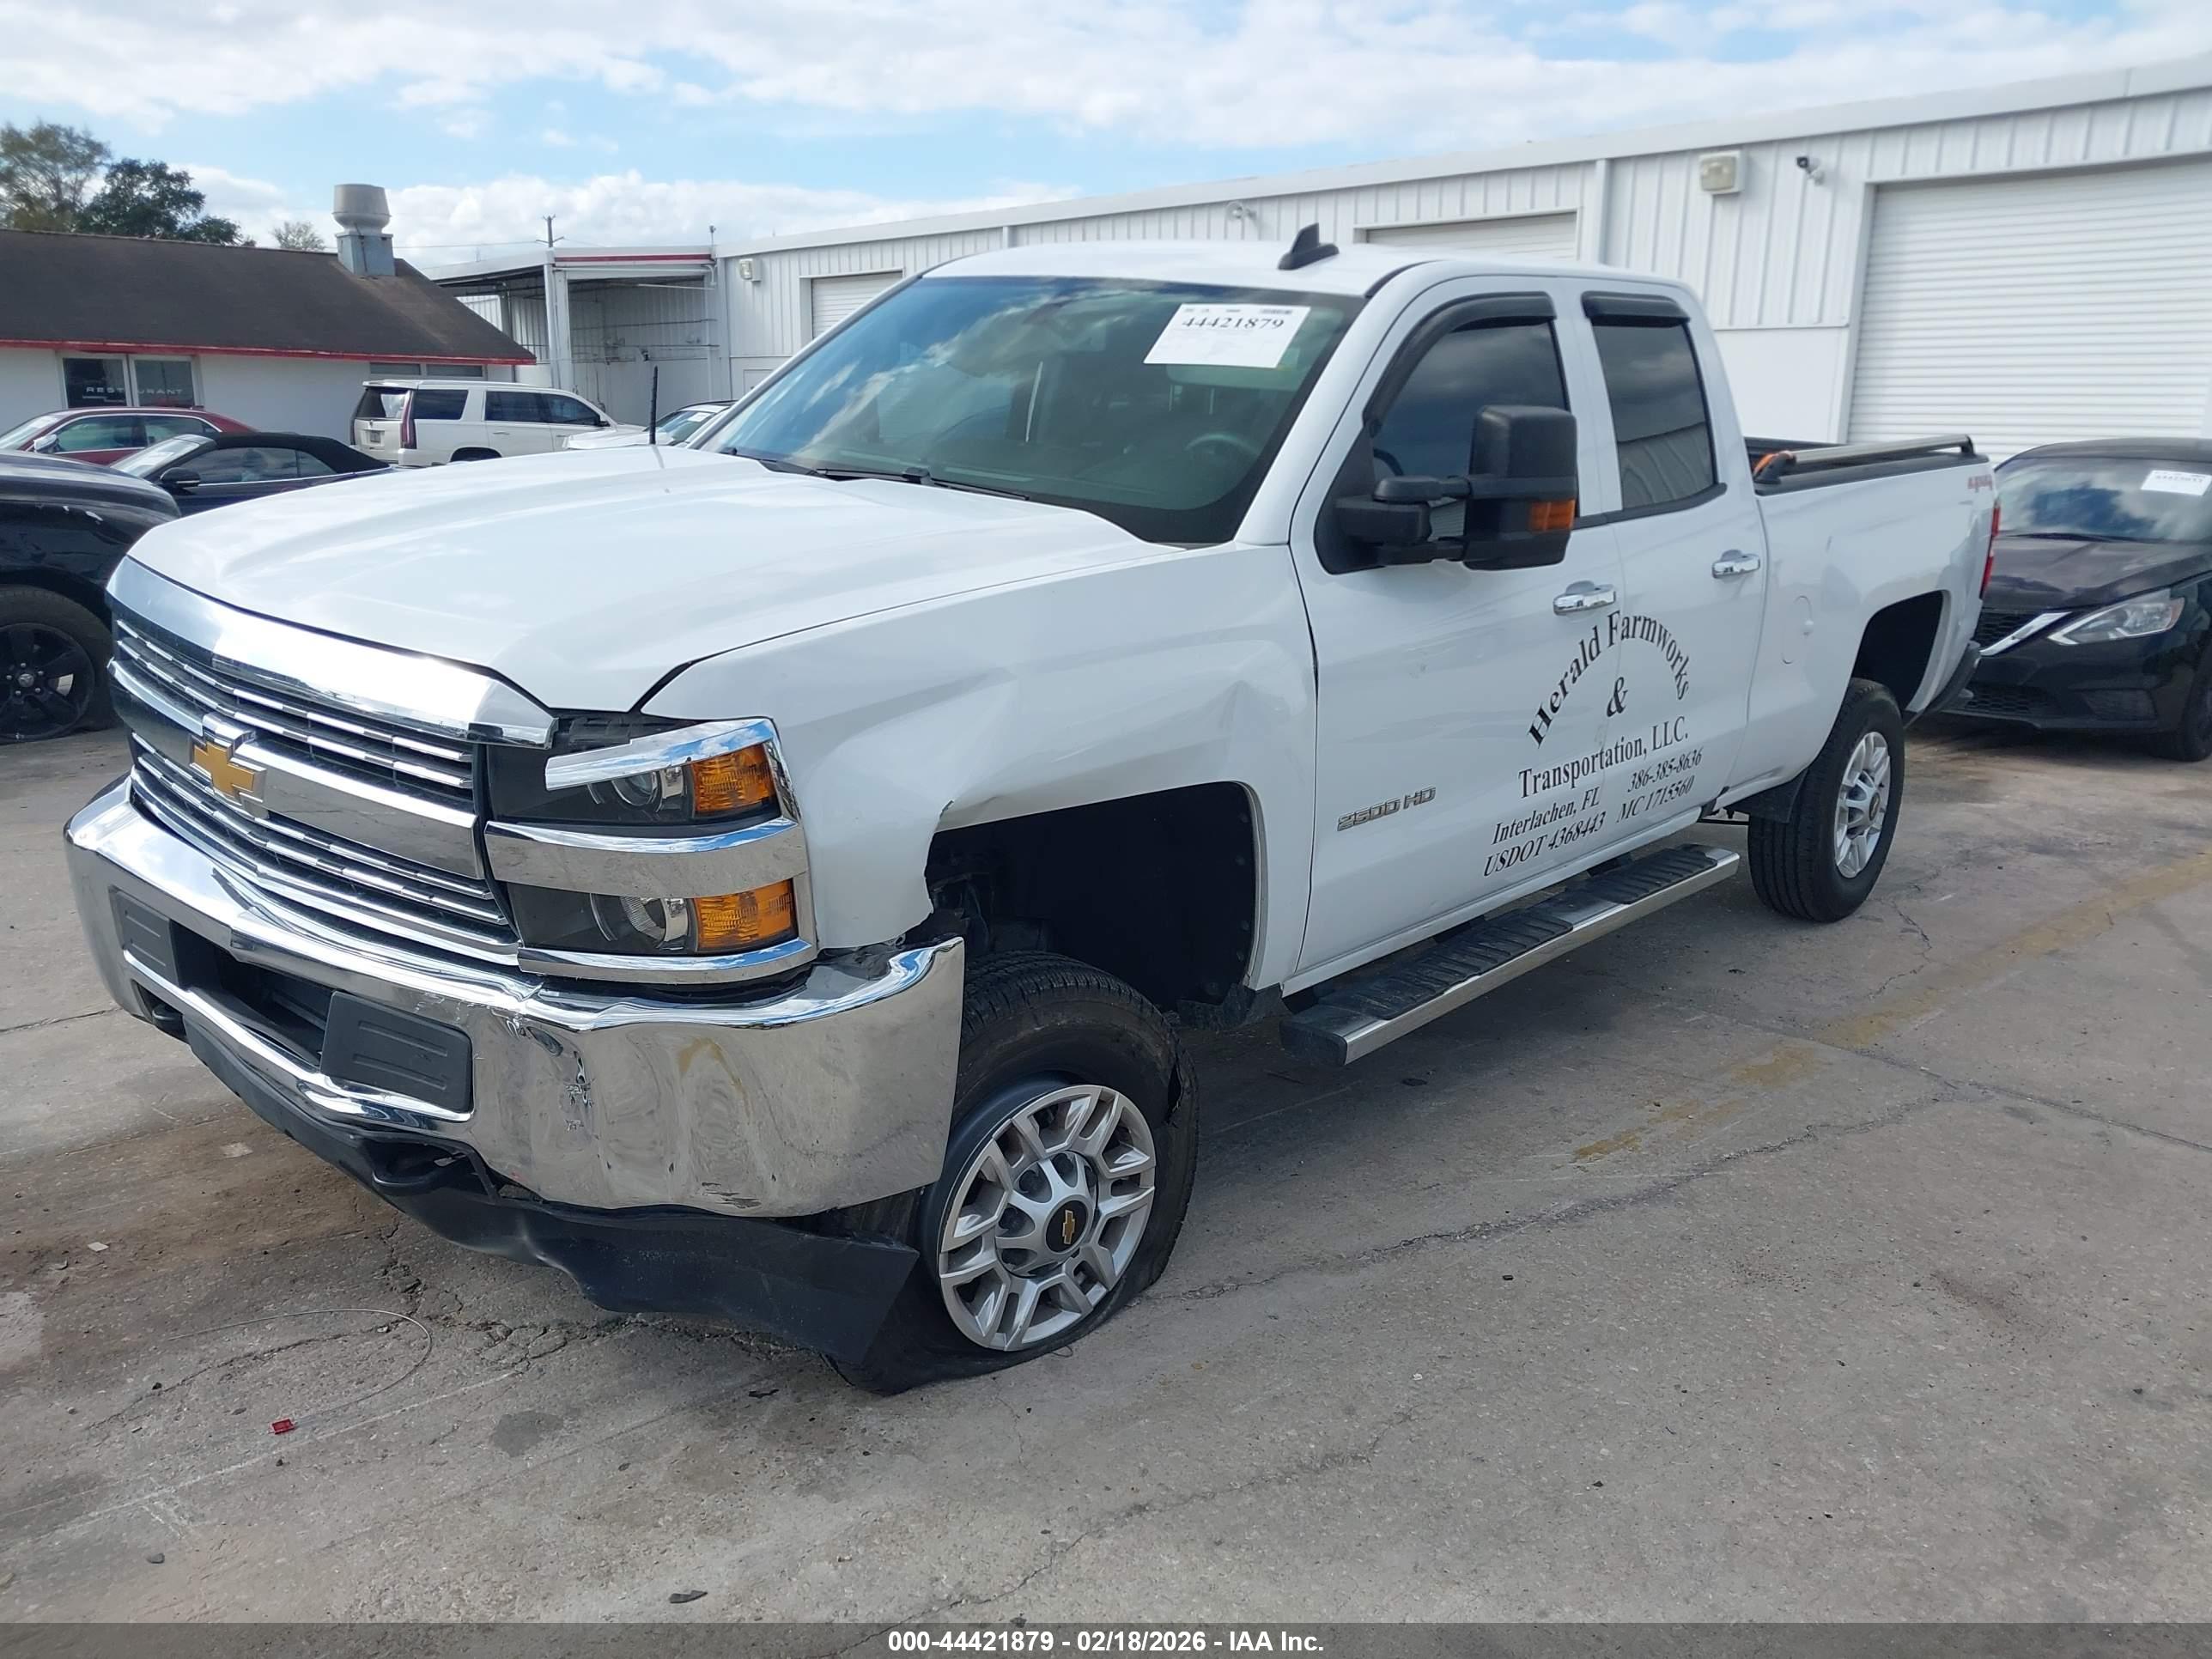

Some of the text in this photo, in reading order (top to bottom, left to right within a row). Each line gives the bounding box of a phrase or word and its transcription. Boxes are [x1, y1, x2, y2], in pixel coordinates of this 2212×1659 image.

[1182, 317, 1285, 330] 44421879
[86, 386, 183, 395] RESTURANT
[1527, 610, 1689, 749] Herald Farmworks
[1606, 677, 1628, 717] &
[1518, 716, 1688, 799] Transportation, LLC.
[1627, 745, 1704, 793] 386-385-8636
[1337, 787, 1437, 831] 2500 HD
[1492, 787, 1601, 845] Interlachen, FL
[1616, 775, 1695, 823] MC 1715560
[1483, 811, 1607, 877] USDOT 4368443
